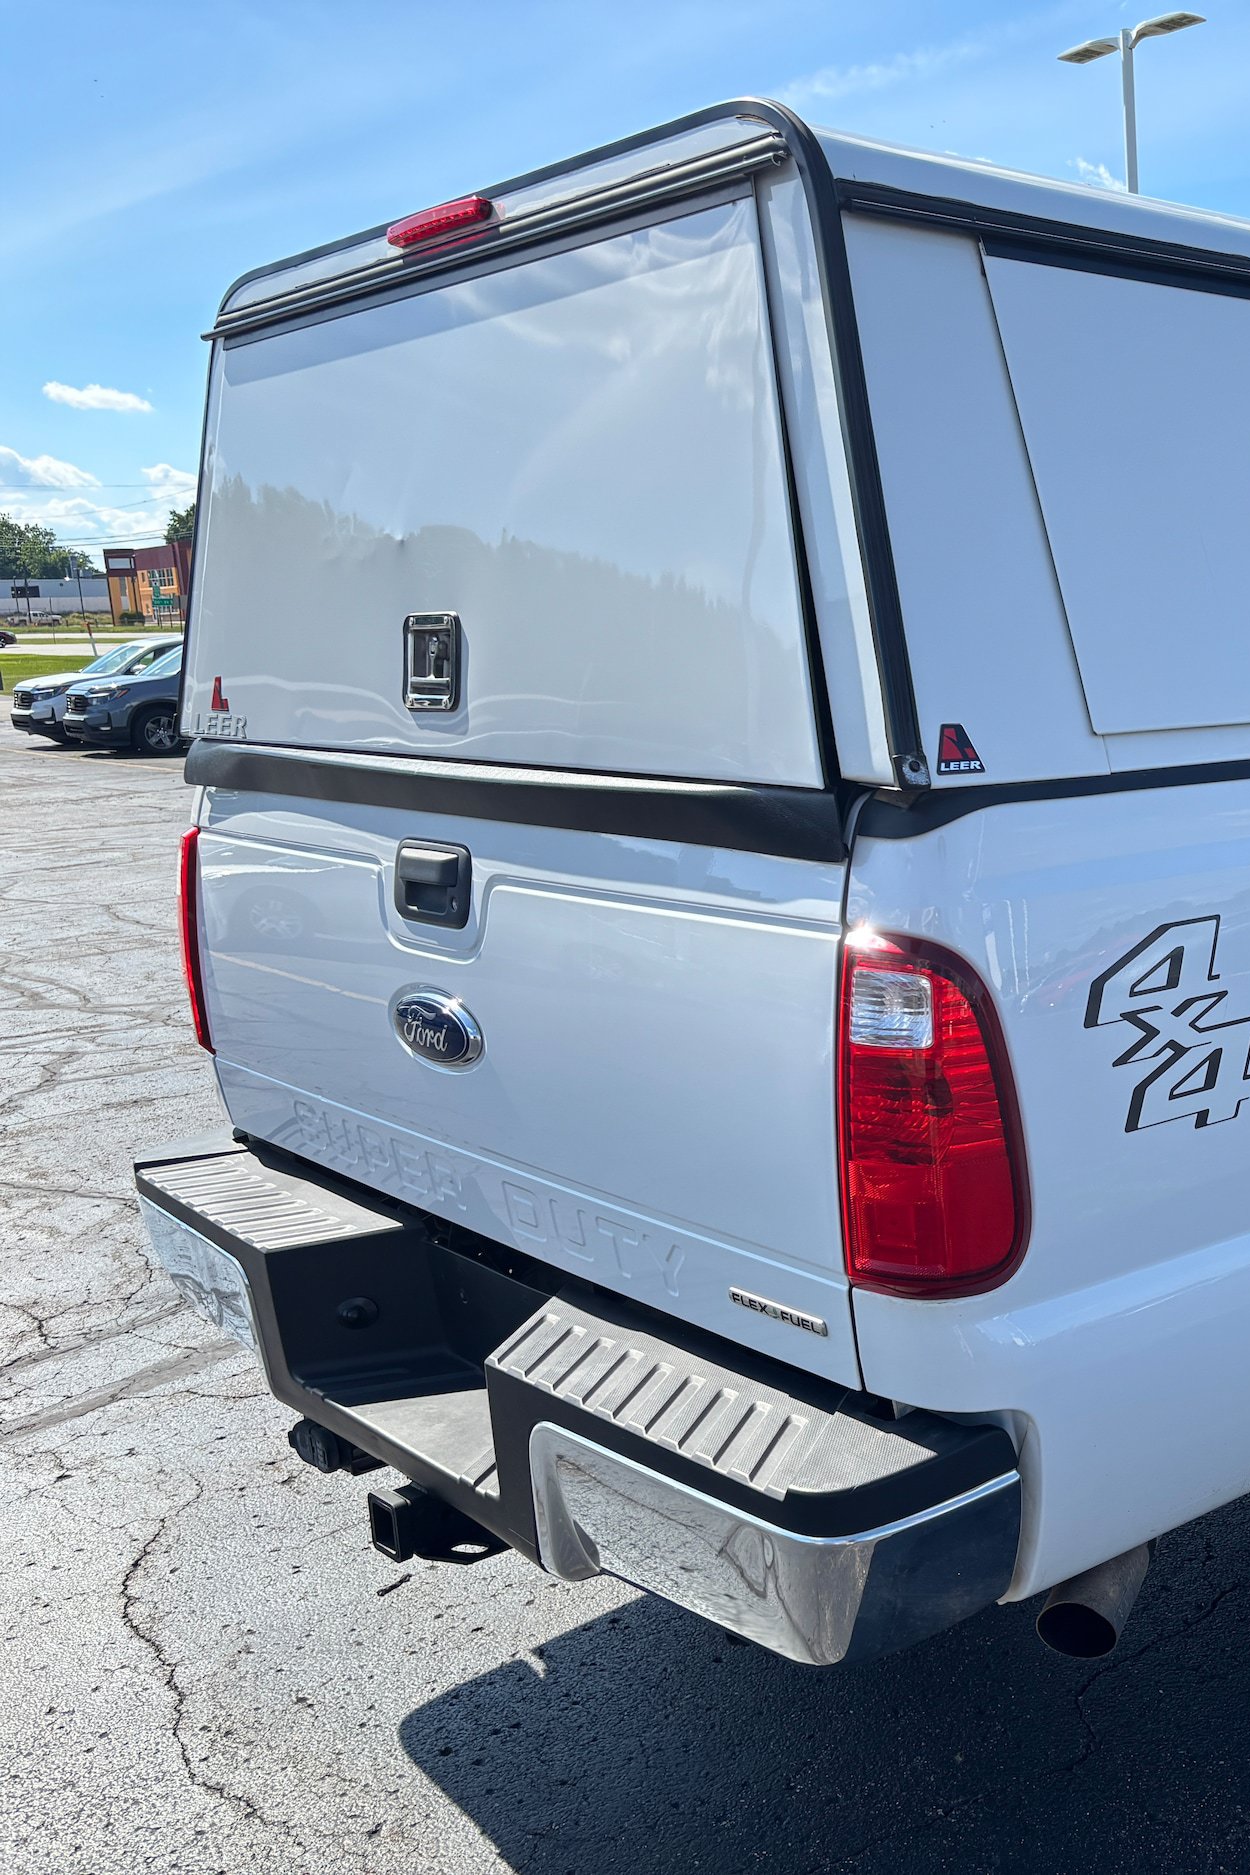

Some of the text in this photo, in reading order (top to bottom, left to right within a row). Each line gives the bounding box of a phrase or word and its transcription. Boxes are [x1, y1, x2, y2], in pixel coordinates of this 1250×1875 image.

[194, 713, 247, 739] LEER
[940, 760, 982, 772] LEER
[399, 1005, 448, 1052] Ford
[293, 1099, 688, 1297] SUPER DUTY
[731, 1292, 821, 1334] FLEX FUEL
